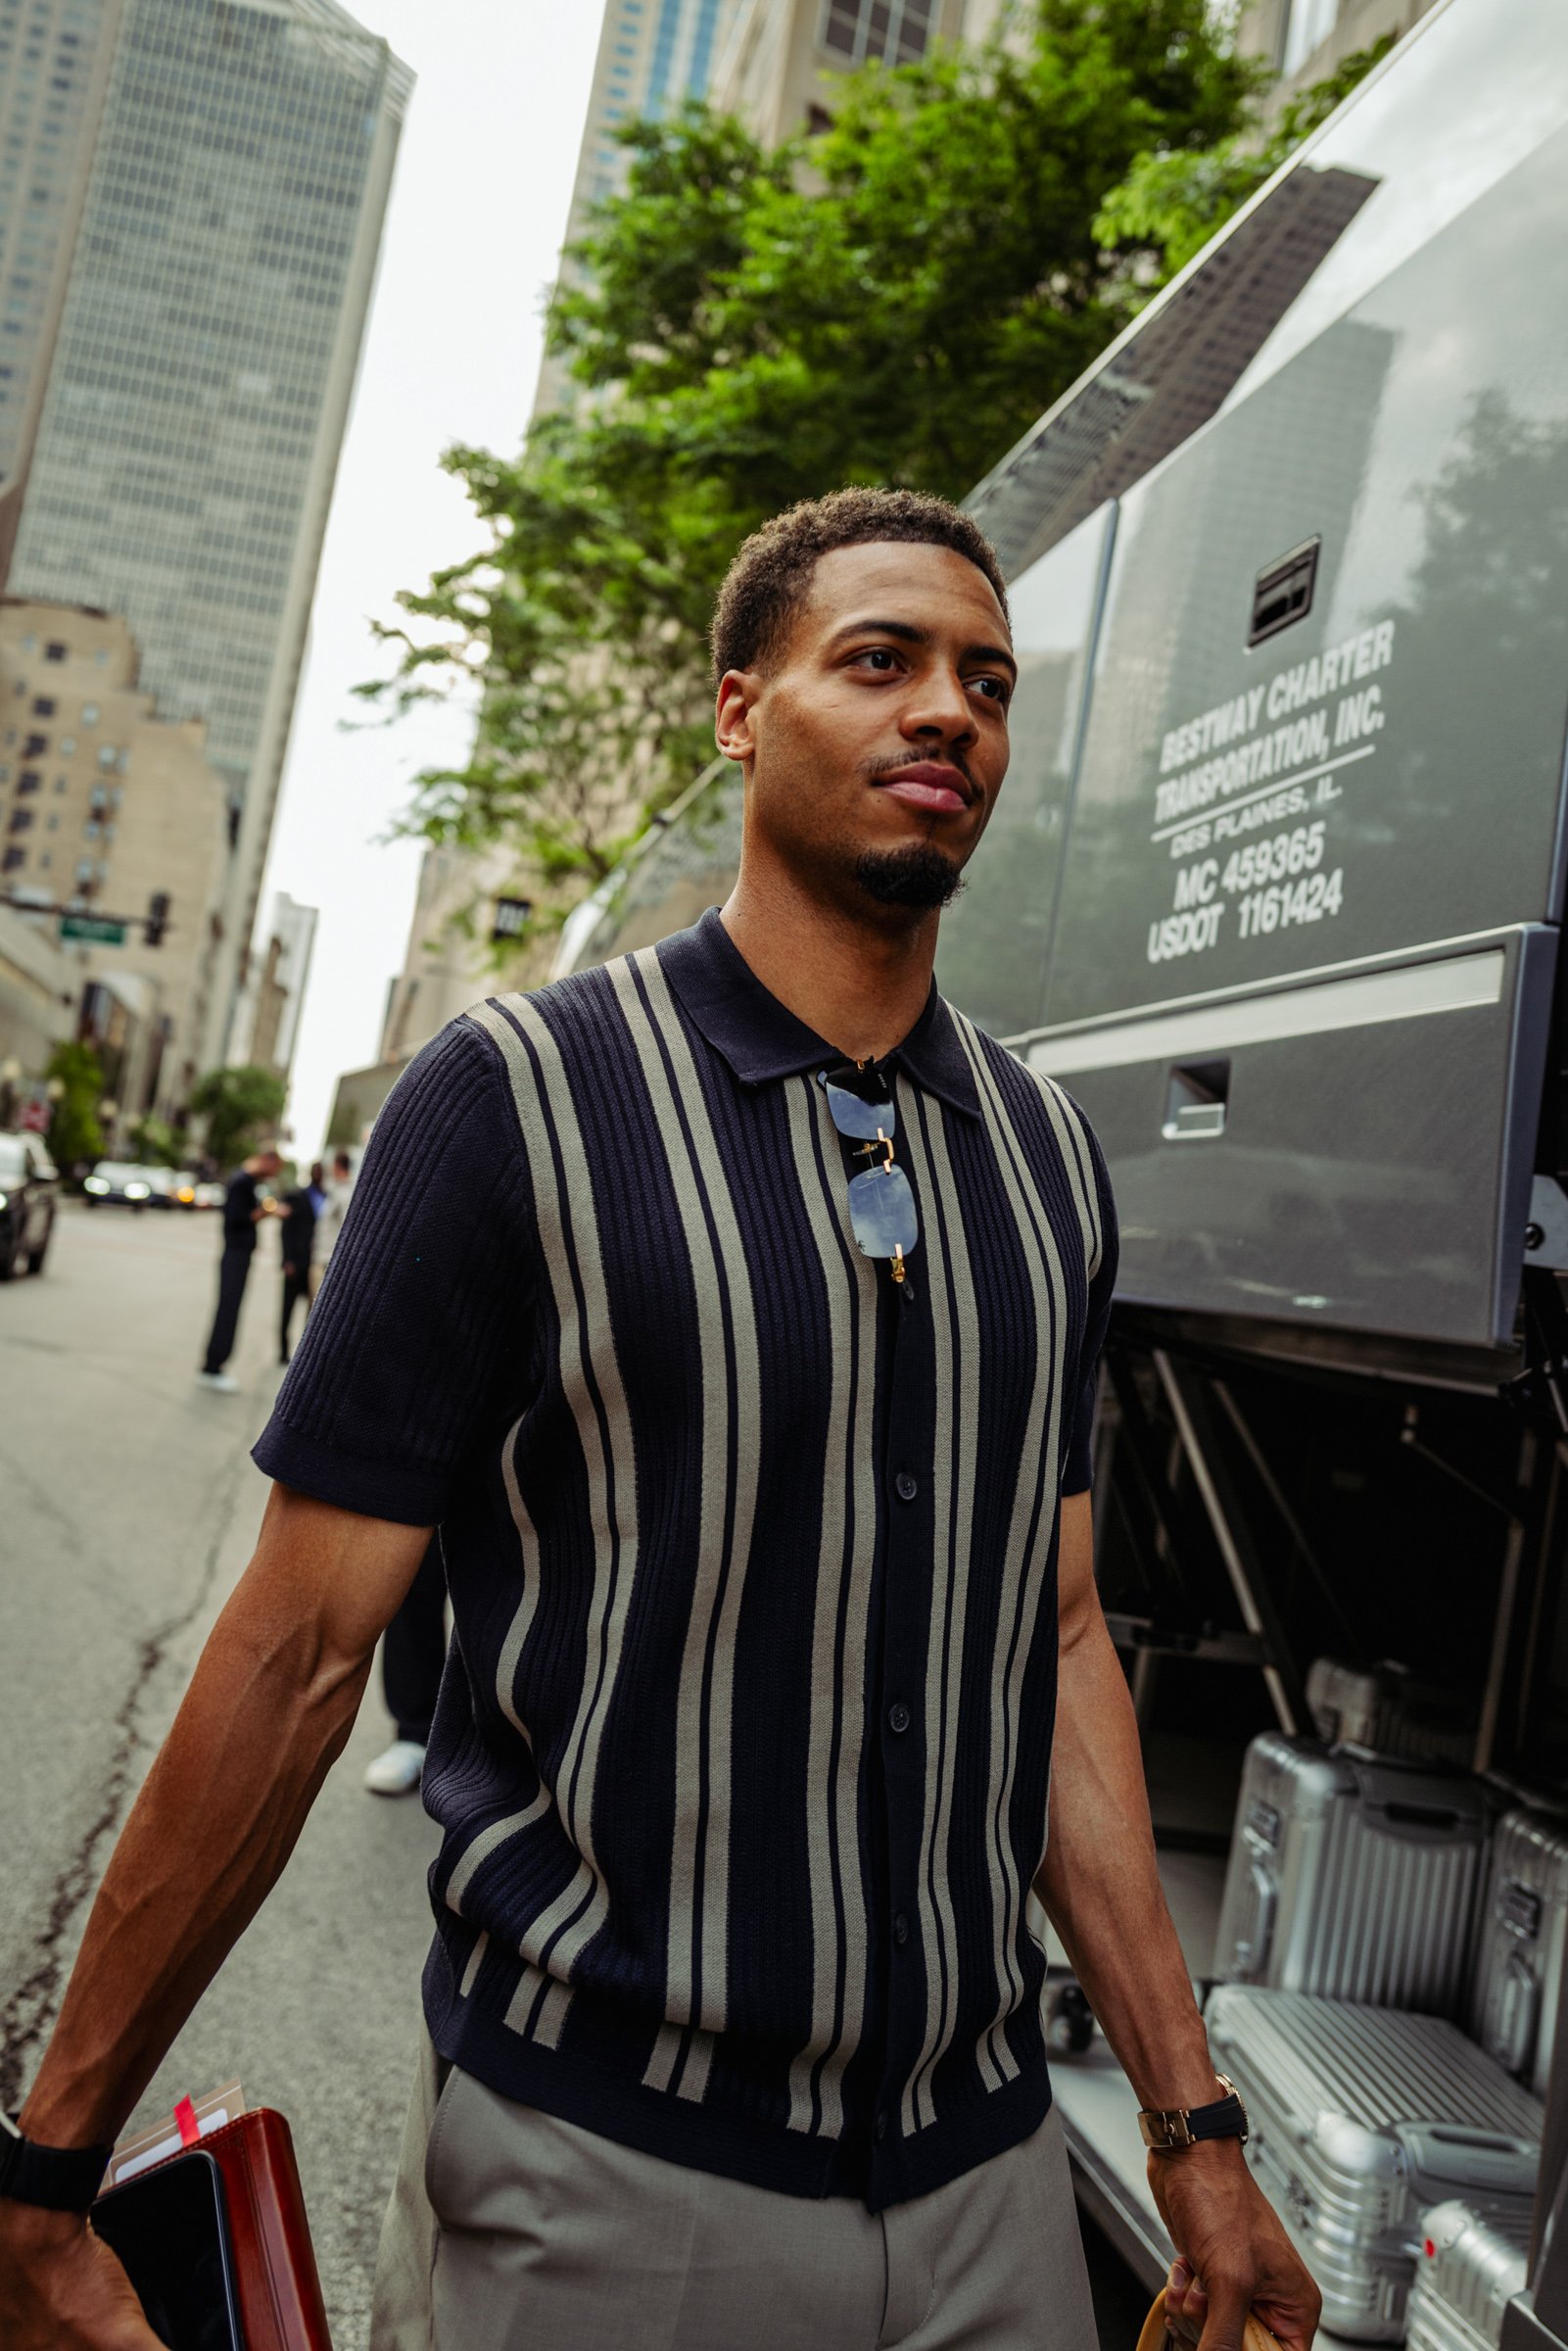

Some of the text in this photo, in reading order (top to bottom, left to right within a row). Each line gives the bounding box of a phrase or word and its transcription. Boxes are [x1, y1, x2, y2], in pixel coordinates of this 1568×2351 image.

[1159, 620, 1395, 774] BESTWAY CHARTER
[1155, 685, 1385, 824] TRANSPORTATION, INC.
[1170, 823, 1212, 859] DES
[1213, 787, 1309, 842] PLAINES,
[1173, 820, 1325, 911] MC 459365
[1148, 868, 1343, 963] USDOT 1161424
